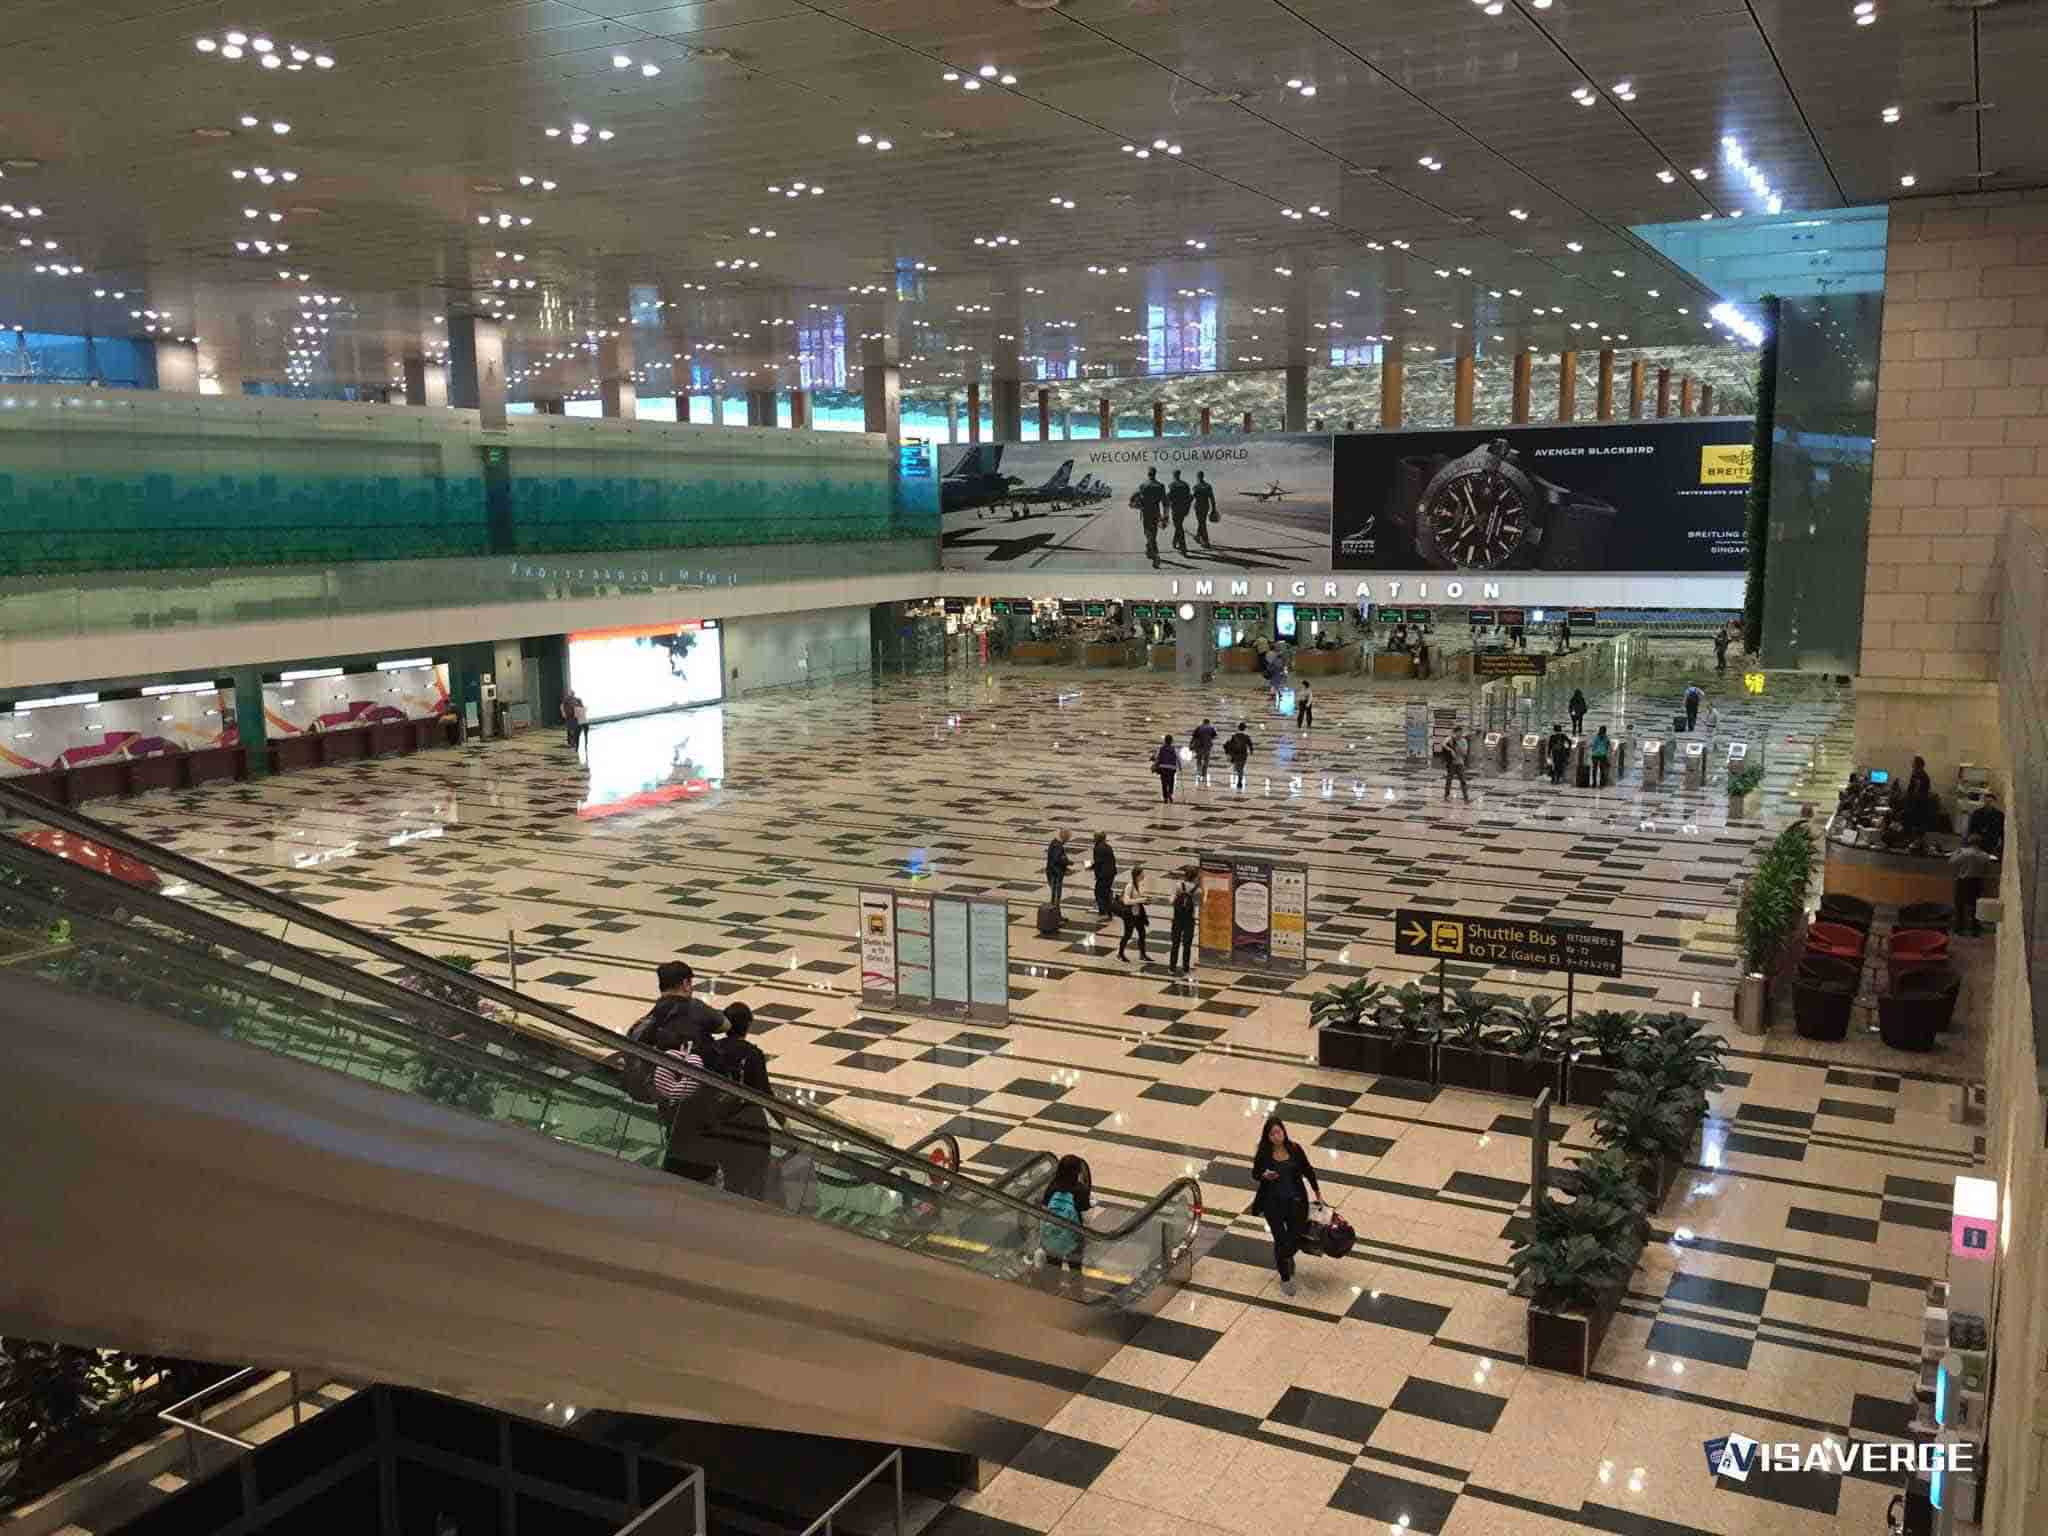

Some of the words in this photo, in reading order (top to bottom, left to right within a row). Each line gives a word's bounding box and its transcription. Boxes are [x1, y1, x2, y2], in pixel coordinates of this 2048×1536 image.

[1088, 450, 1149, 464] WELCOME
[1152, 450, 1169, 462] TO
[1172, 449, 1200, 462] OUR
[1201, 448, 1249, 461] WORLD
[1534, 447, 1585, 457] AVENGER
[1588, 446, 1655, 456] BLACKBIRD
[1707, 467, 1752, 476] BREITL
[1710, 545, 1750, 554] SINGAP
[1171, 580, 1500, 599] IMMIGRATION
[1468, 923, 1525, 942] Shuttle
[1528, 929, 1558, 947] Bus
[1468, 943, 1486, 957] to
[1488, 943, 1508, 960] T2
